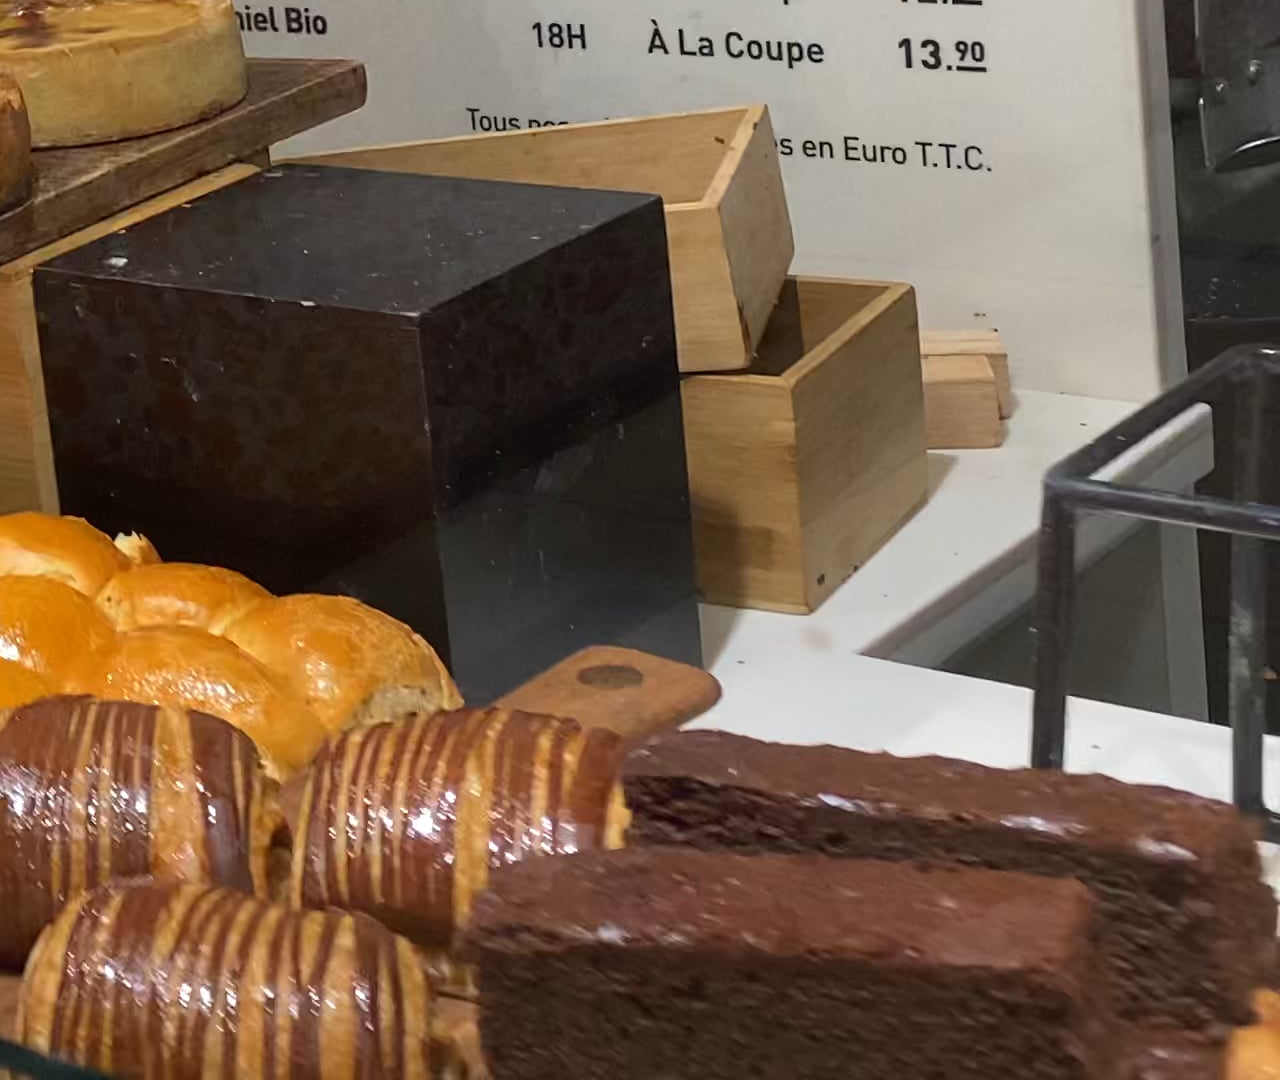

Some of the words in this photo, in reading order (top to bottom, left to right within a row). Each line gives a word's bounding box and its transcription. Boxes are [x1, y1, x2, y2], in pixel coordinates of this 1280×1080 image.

[466, 108, 521, 131] Tous
[802, 140, 834, 158] en
[844, 136, 907, 164] Euro
[915, 142, 991, 171] T.T.C.
